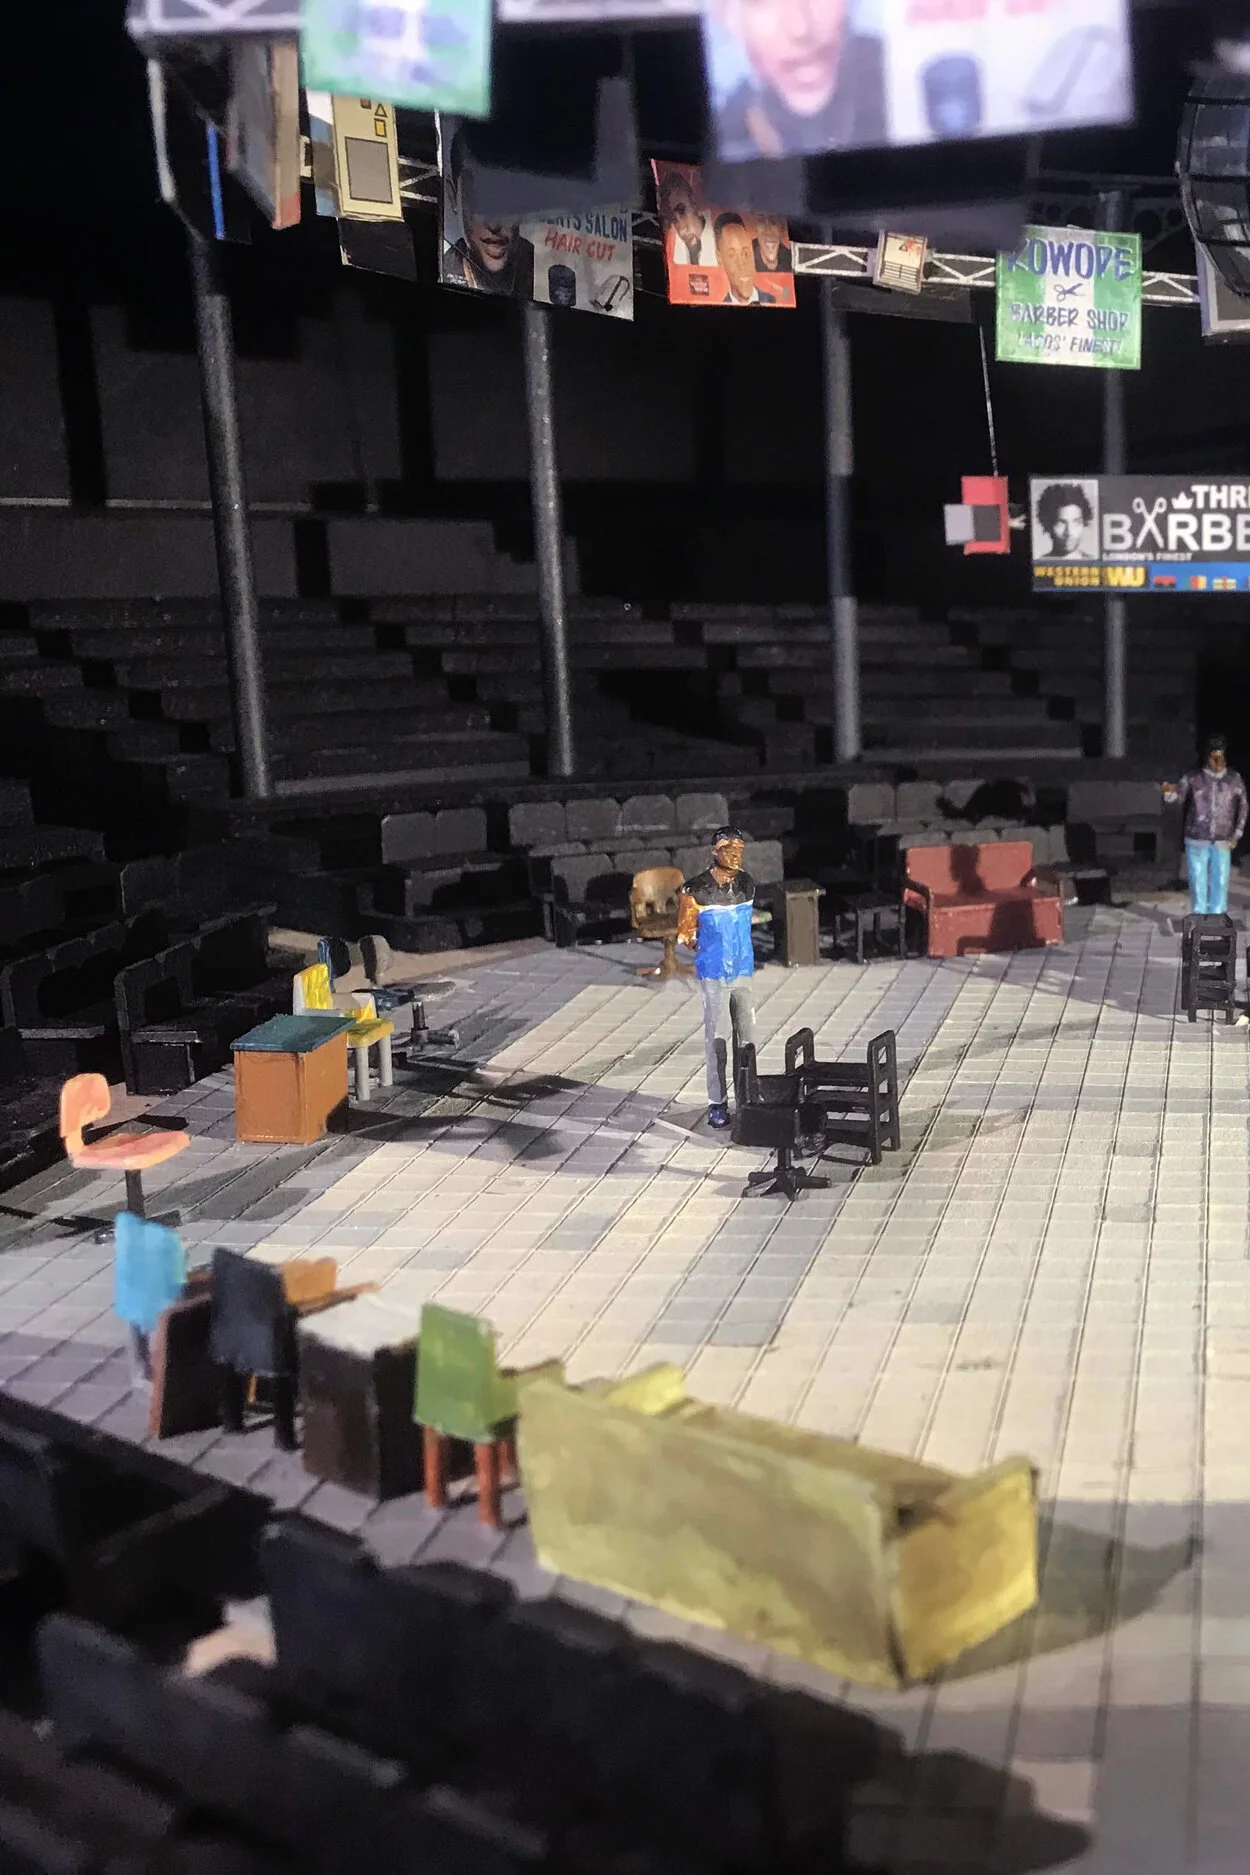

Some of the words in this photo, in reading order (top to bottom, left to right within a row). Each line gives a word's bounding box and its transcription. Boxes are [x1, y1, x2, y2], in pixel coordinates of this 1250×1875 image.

[586, 213, 628, 243] SALON
[544, 228, 581, 254] HAIR
[587, 241, 616, 262] CUT
[1010, 302, 1079, 327] BARBER
[1087, 308, 1129, 332] SHOP
